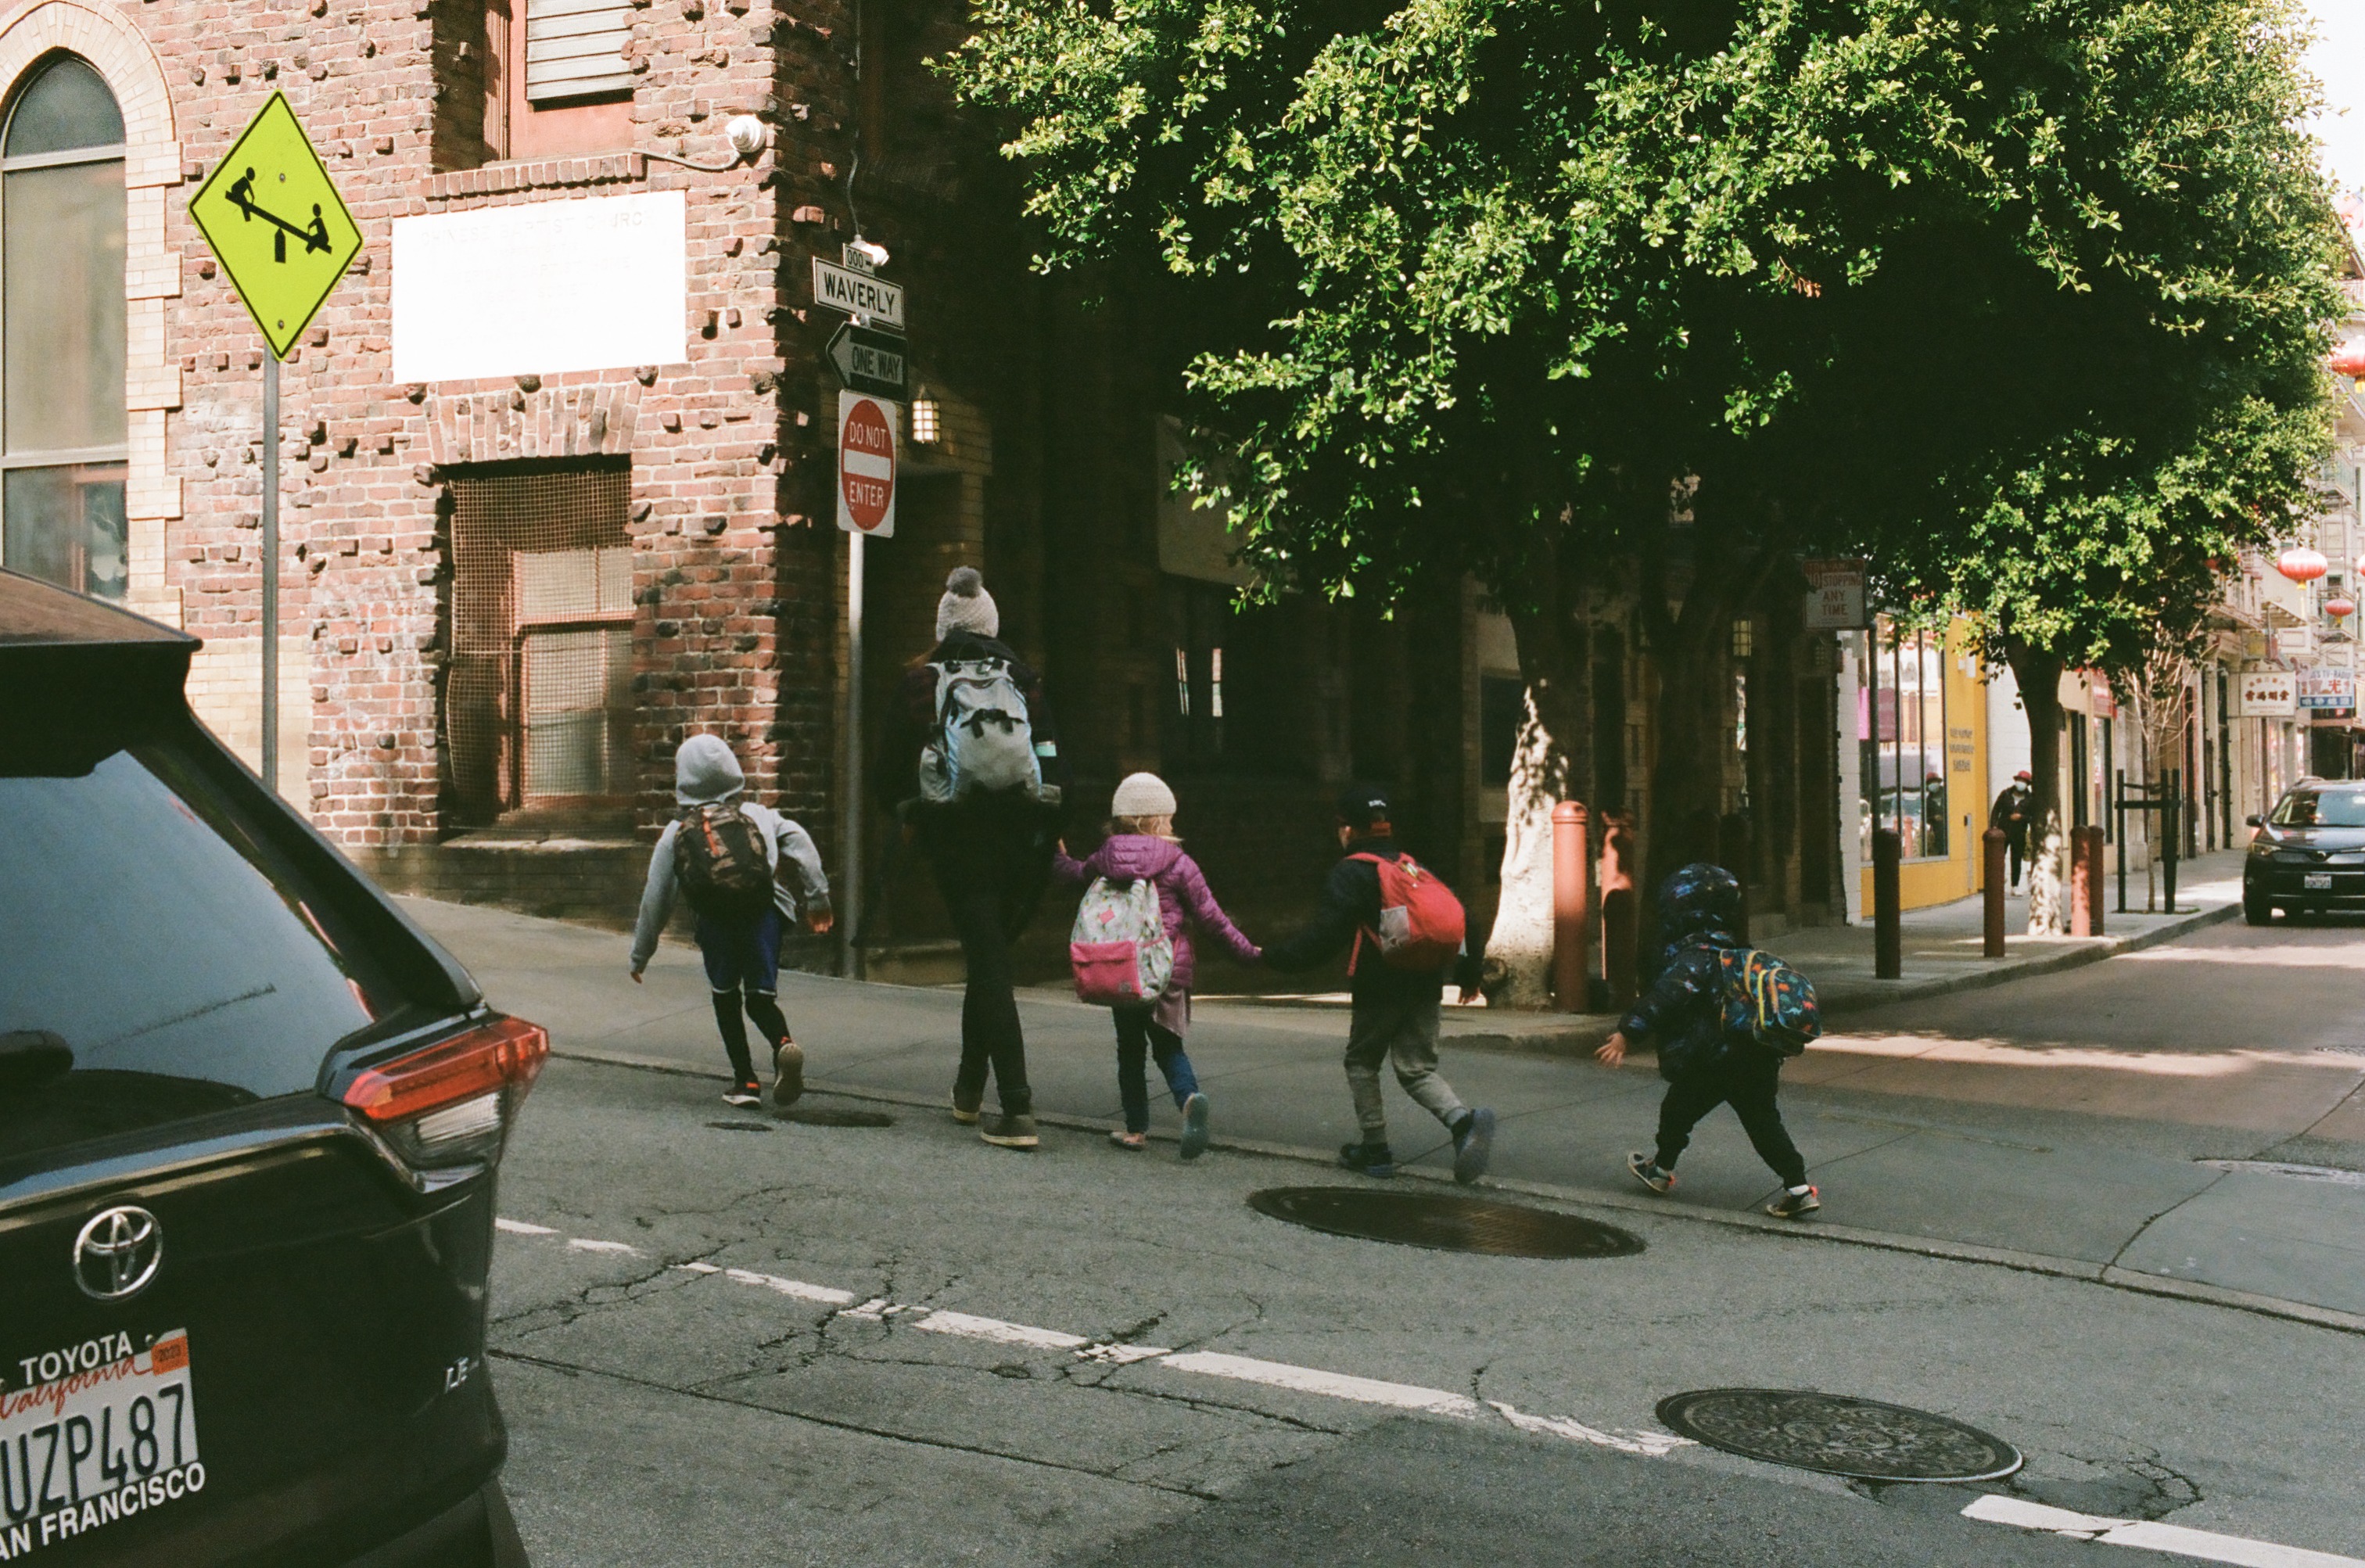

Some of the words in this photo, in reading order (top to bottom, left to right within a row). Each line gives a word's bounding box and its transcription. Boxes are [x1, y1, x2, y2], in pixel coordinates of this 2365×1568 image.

[824, 271, 895, 316] WAVERLY
[852, 346, 874, 375] ONE
[877, 351, 901, 382] WAY
[849, 421, 863, 445] DO
[866, 425, 887, 450] NOT
[849, 481, 885, 509] ENTER
[1823, 575, 1862, 587] STOPPING
[1823, 589, 1846, 602] ANY
[1821, 604, 1847, 616] TIME
[19, 1330, 133, 1385] TOYOTA
[41, 1462, 206, 1546] FRANCISCO
